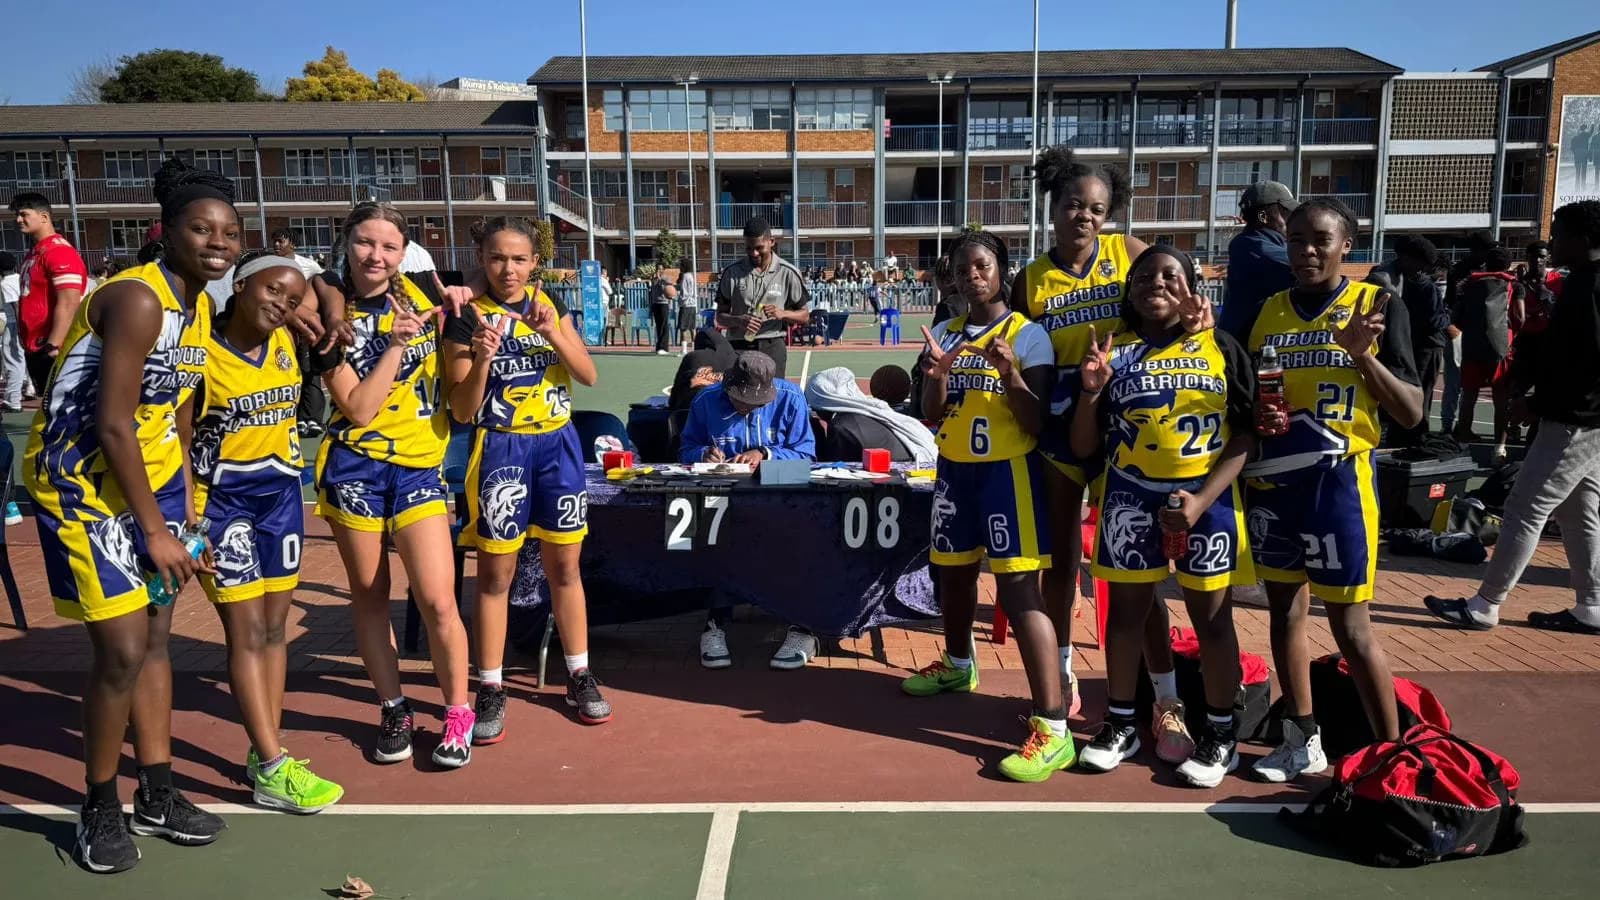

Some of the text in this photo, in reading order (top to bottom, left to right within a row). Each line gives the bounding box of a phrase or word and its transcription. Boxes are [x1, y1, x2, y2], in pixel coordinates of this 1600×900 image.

[1045, 283, 1120, 311] JOBURG
[1044, 302, 1121, 331] ARRIOR
[497, 333, 550, 356] JOBU
[1265, 330, 1338, 347] JOBUR
[490, 351, 559, 377] WARRIO
[1118, 358, 1209, 378] JOBURG
[1279, 350, 1358, 368] RRIORS
[948, 375, 1005, 394] RRIORS
[1110, 374, 1225, 402] WARRIORS
[1315, 382, 1356, 421] 21
[969, 416, 991, 457] 6
[1176, 411, 1224, 458] 22
[558, 490, 587, 528] 26
[667, 496, 729, 550] 27
[843, 496, 900, 549] 08
[988, 513, 1010, 552] 6
[282, 533, 300, 570] 0
[1187, 531, 1231, 573] 22
[1300, 533, 1342, 570] 21
